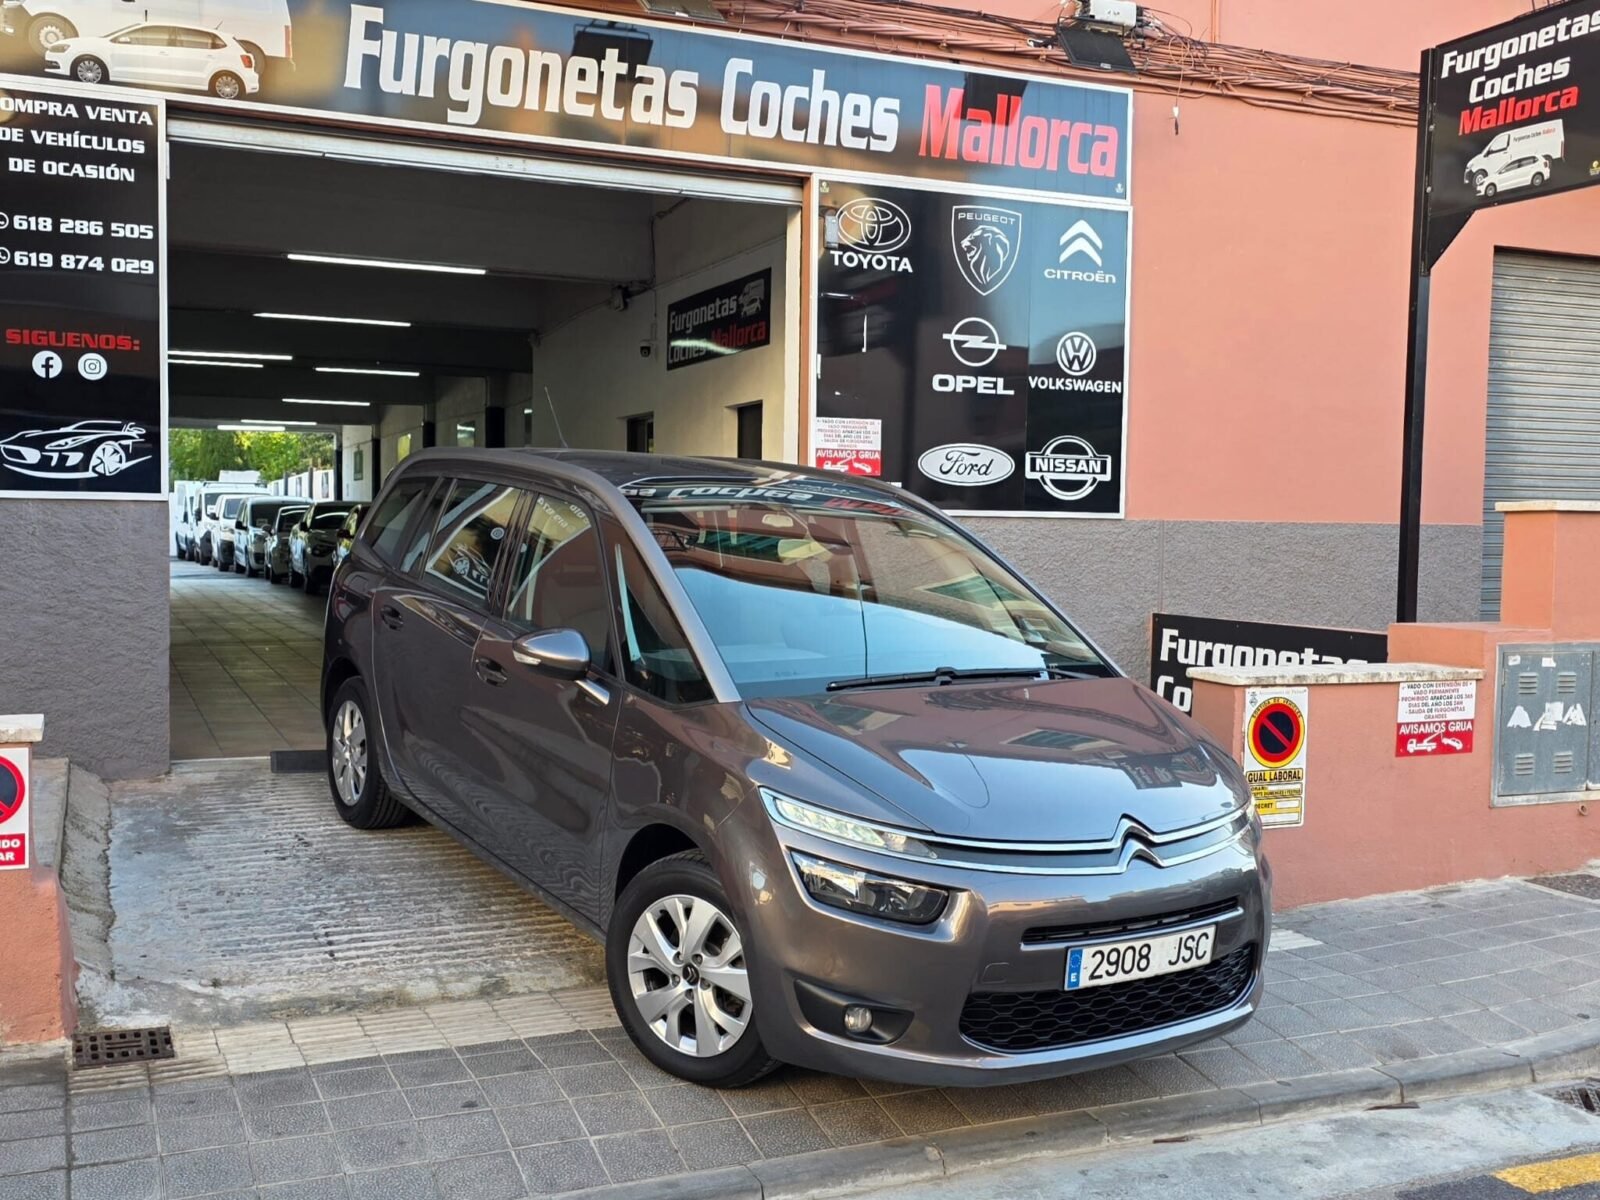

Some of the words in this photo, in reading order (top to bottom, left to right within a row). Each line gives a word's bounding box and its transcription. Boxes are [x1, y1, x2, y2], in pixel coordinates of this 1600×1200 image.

[343, 2, 699, 128] Furgonetas
[720, 57, 900, 153] Coches
[918, 83, 1119, 178] Mallorca
[1469, 56, 1571, 104] Coches
[0, 96, 79, 118] OMPRA
[84, 105, 153, 126] VENTA
[1458, 85, 1580, 136] Mallorca
[0, 127, 24, 143] DE
[30, 129, 145, 154] VEHÍCULOS
[8, 157, 36, 173] DE
[42, 160, 135, 182] OCASIÓN
[13, 215, 52, 232] 618
[60, 219, 104, 237] 286
[111, 222, 154, 240] 505
[958, 211, 1017, 226] PEUGEOT
[14, 251, 53, 268] 619
[61, 254, 105, 271] 874
[111, 257, 154, 275] 029
[830, 250, 913, 273] TOYOTA
[669, 296, 738, 334] Furgonetas
[6, 329, 140, 350] SIGUENOS:
[932, 374, 1015, 395] OPEL
[1028, 376, 1122, 393] VOLKSWAGEN
[816, 449, 857, 459] AVISAMOS
[858, 450, 880, 460] GRUA
[939, 450, 994, 476] Ford
[1035, 458, 1102, 474] NISSAN
[1160, 628, 1368, 667] Furgonet
[1399, 722, 1447, 735] AVISAMOS
[1448, 721, 1473, 732] GRUA
[1247, 772, 1268, 783] GUAL
[1269, 770, 1301, 781] LABORAL
[1088, 943, 1152, 981] 2908
[1168, 932, 1210, 966] JSC
